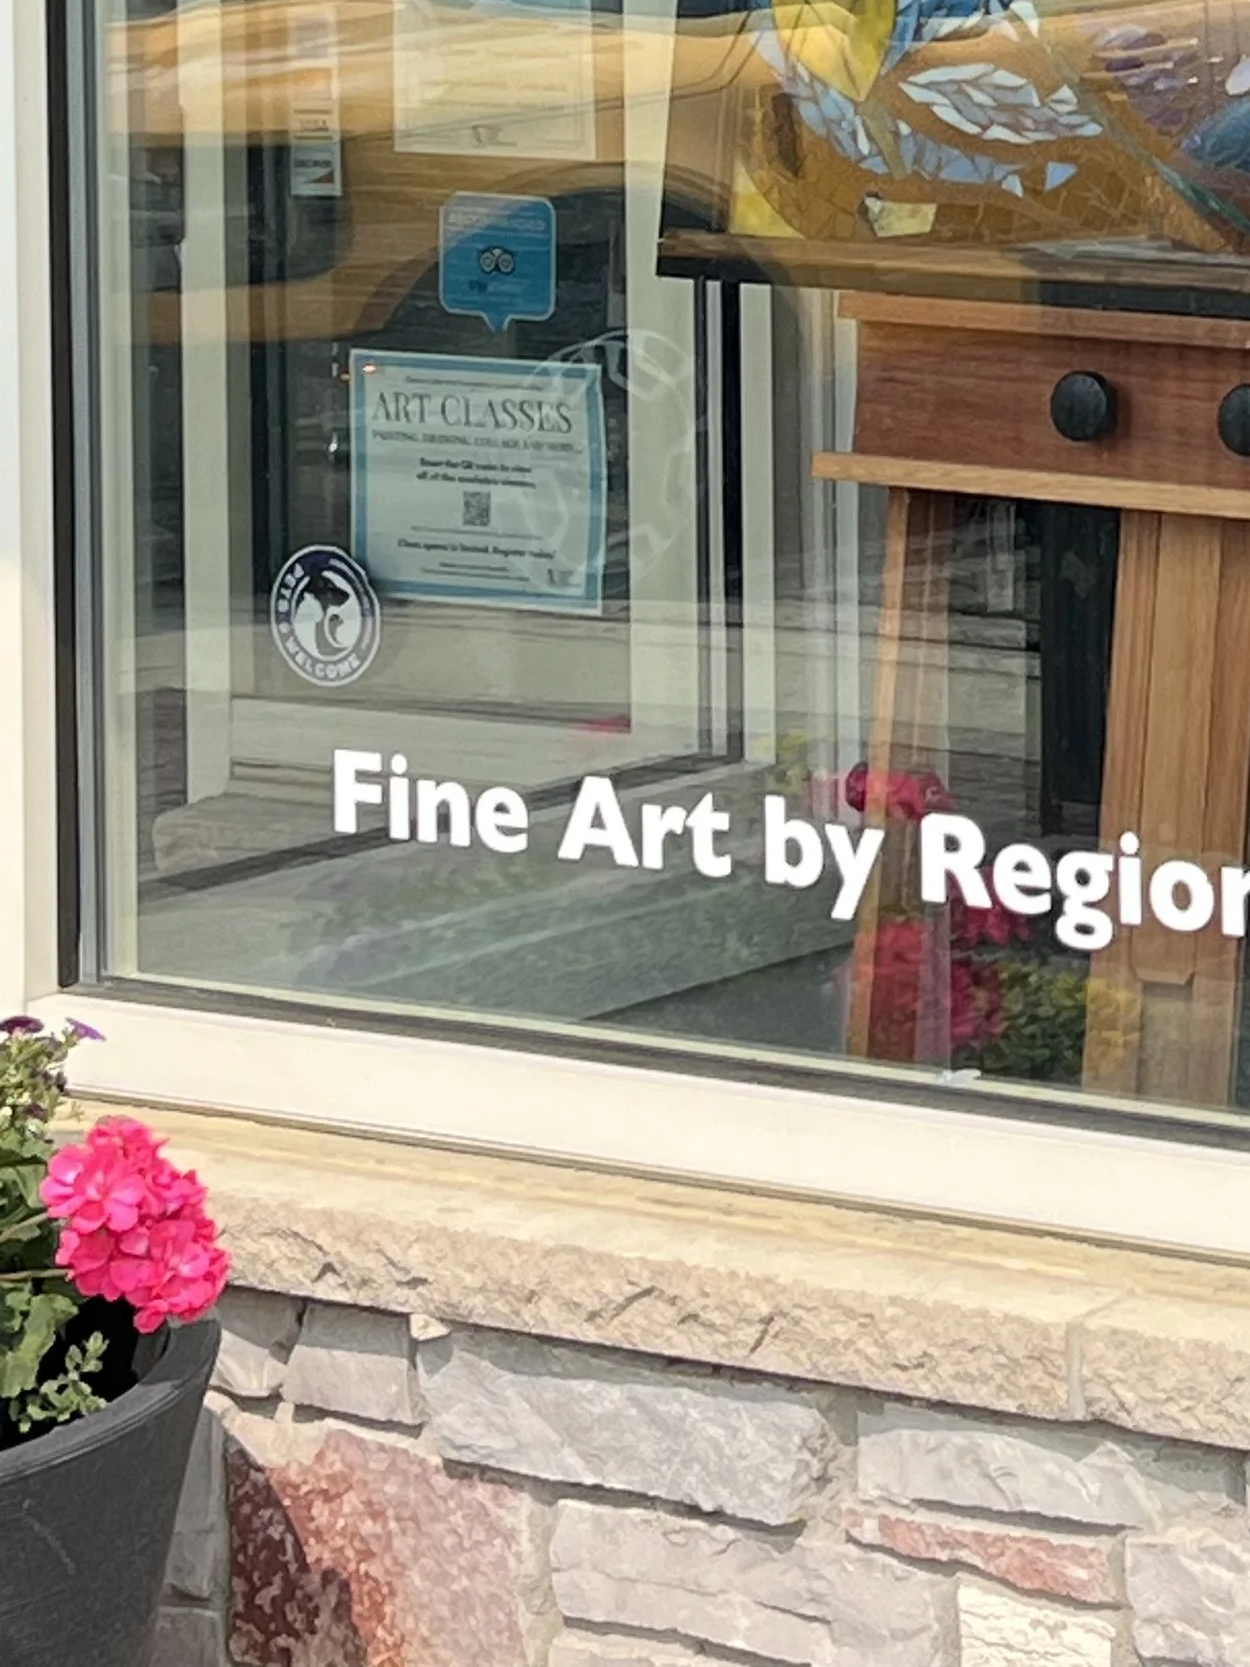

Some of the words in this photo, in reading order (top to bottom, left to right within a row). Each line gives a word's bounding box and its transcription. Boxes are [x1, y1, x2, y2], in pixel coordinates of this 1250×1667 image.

[371, 391, 433, 424] ART
[441, 394, 574, 435] CLASSES
[332, 748, 530, 854] Fine
[557, 774, 733, 878] Art
[763, 793, 886, 921] by
